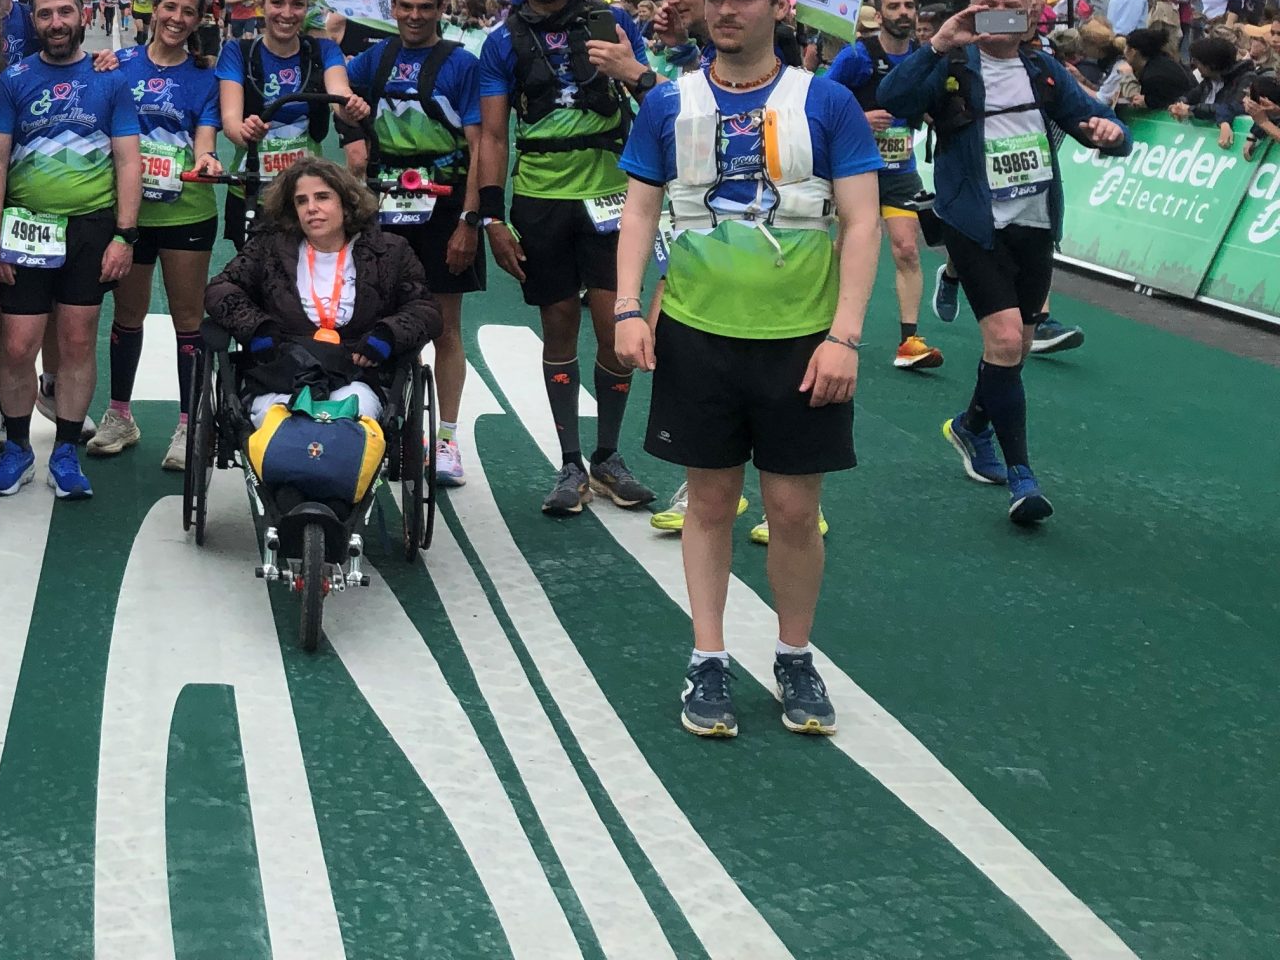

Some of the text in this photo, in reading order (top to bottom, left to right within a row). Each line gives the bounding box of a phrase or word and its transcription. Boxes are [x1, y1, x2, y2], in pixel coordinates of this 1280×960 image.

[141, 140, 177, 152] Schneider
[271, 136, 308, 147] Schneider
[877, 138, 905, 152] 2683
[141, 155, 171, 177] 5199
[992, 150, 1039, 175] 49863
[1117, 178, 1210, 224] Electric
[401, 214, 420, 222] asics
[11, 220, 51, 243] 49814
[26, 257, 46, 265] asics
